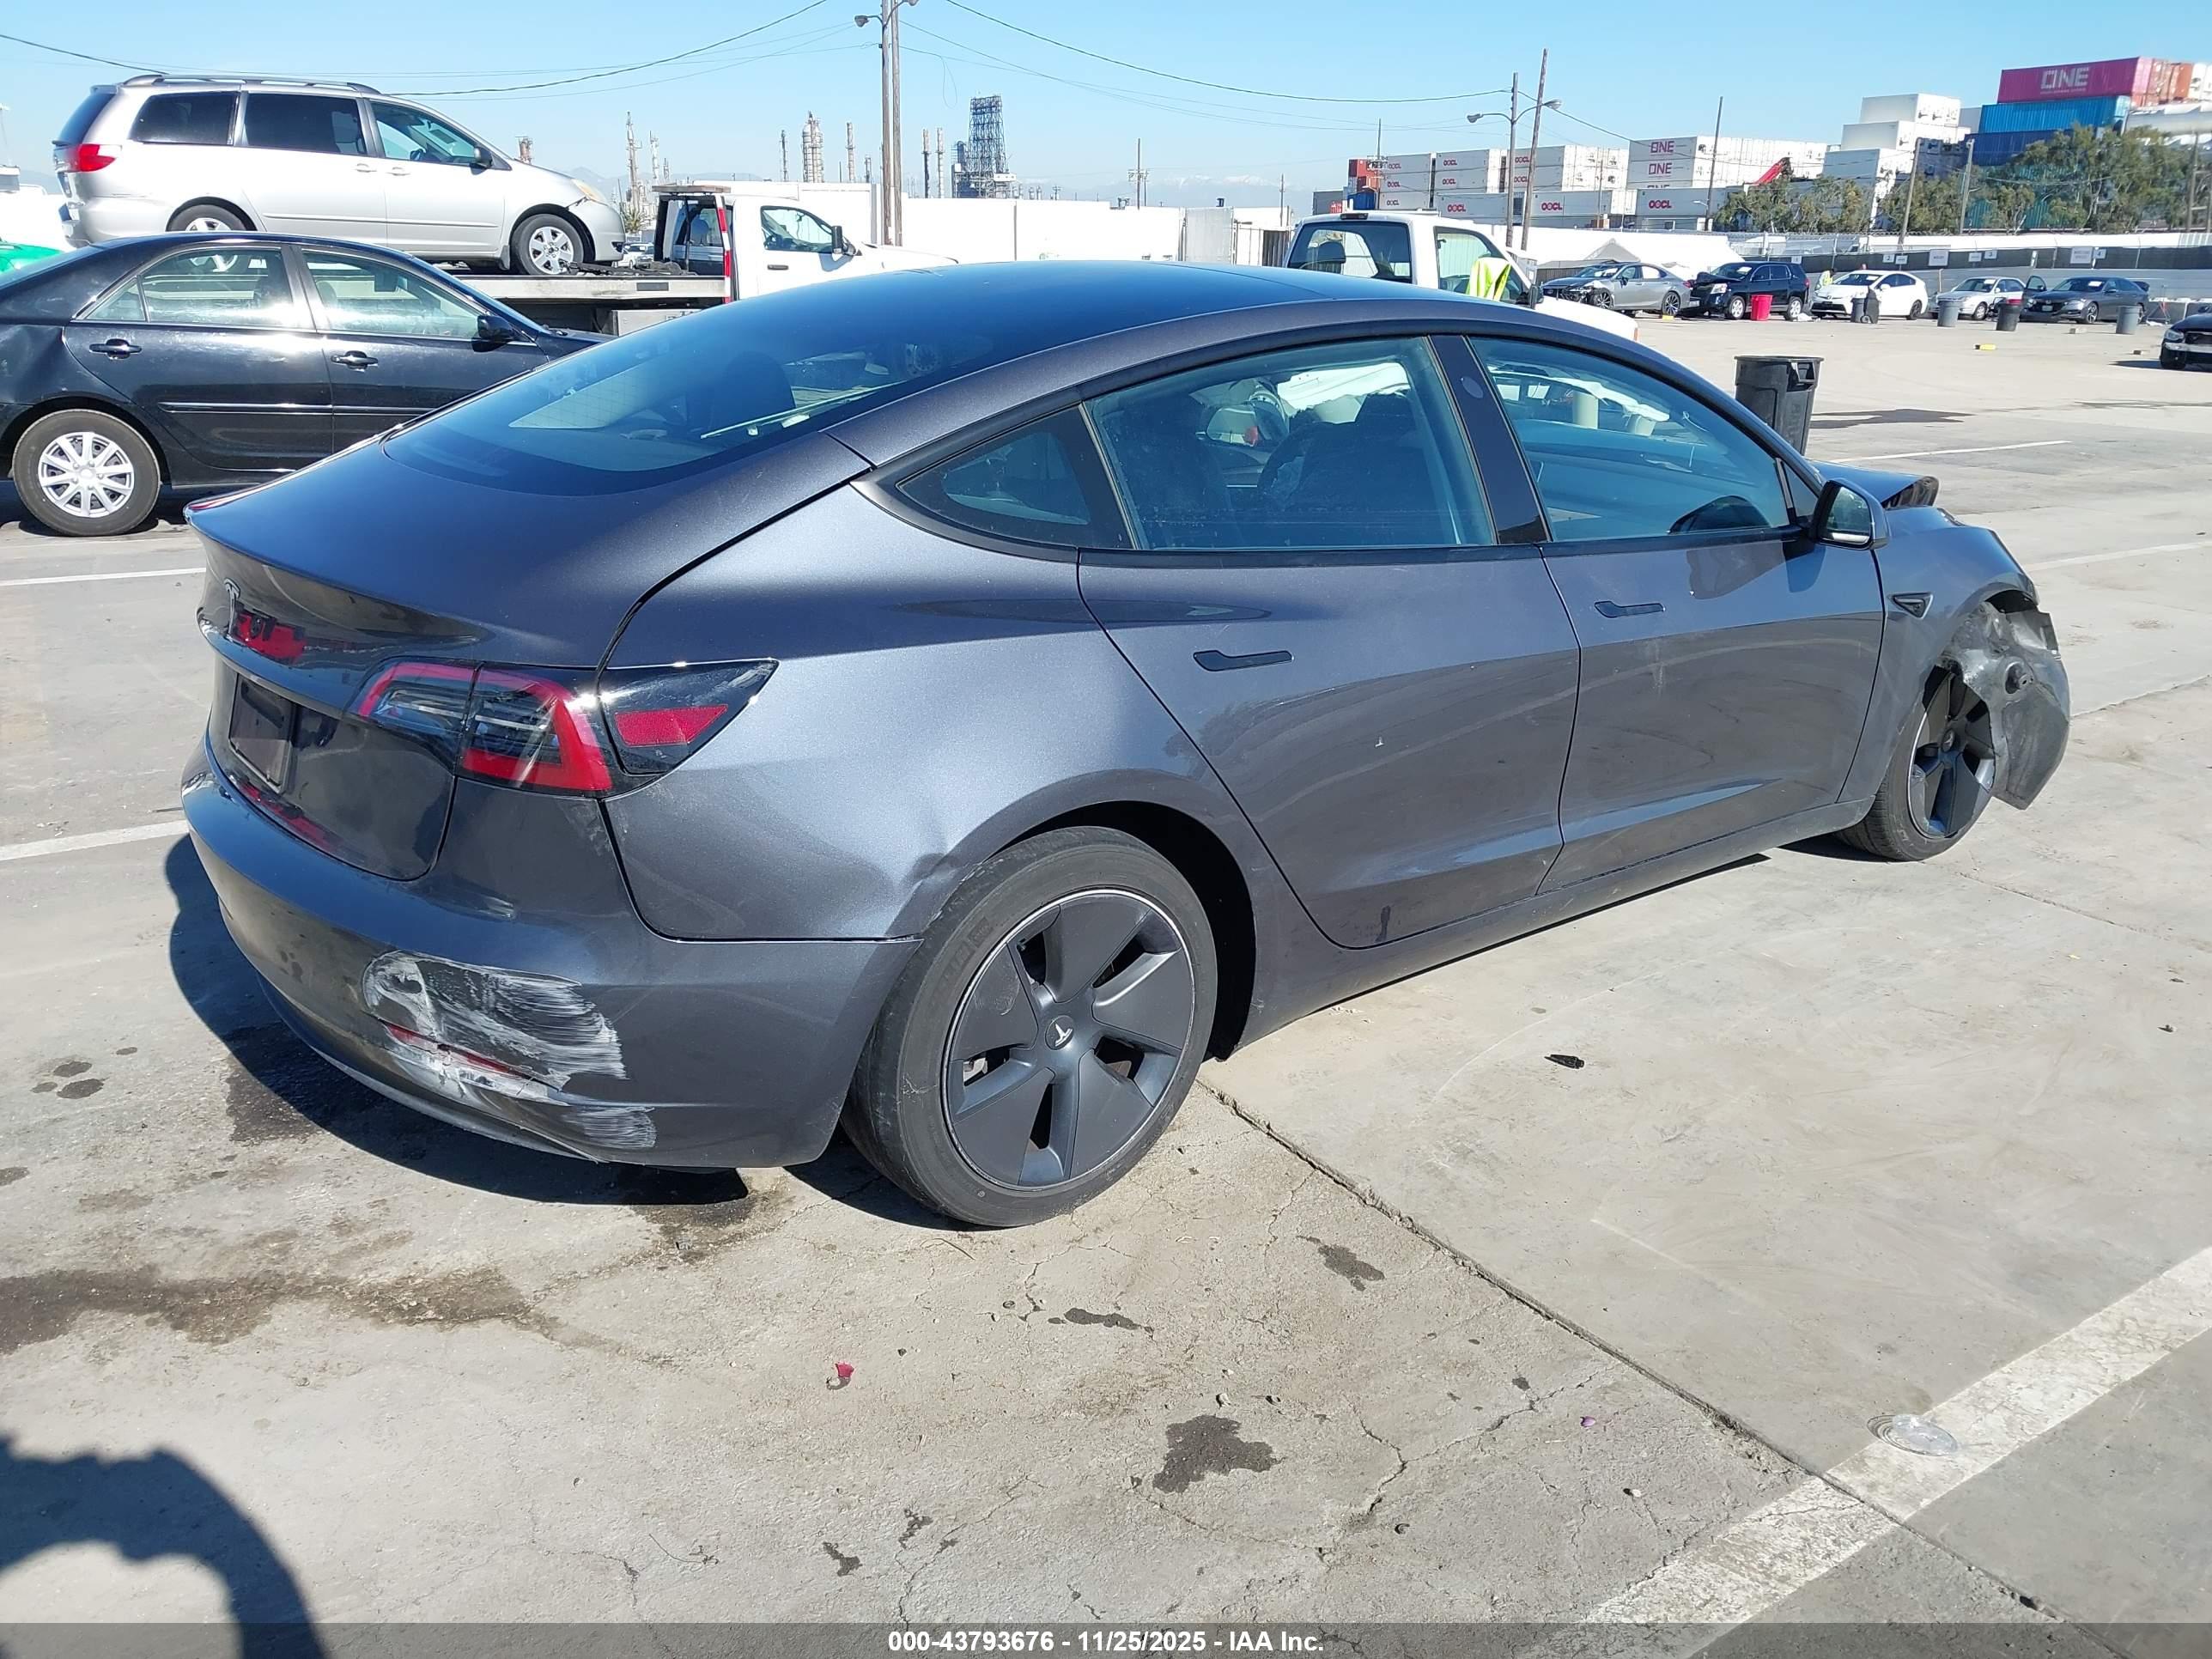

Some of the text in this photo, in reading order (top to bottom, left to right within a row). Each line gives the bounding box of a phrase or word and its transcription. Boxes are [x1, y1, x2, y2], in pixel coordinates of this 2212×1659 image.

[2040, 67, 2089, 89] ONE
[1650, 140, 1674, 153] ONE
[1648, 162, 1673, 175] ONE
[1541, 202, 1563, 211] OOCL
[1648, 200, 1672, 209] OOCL
